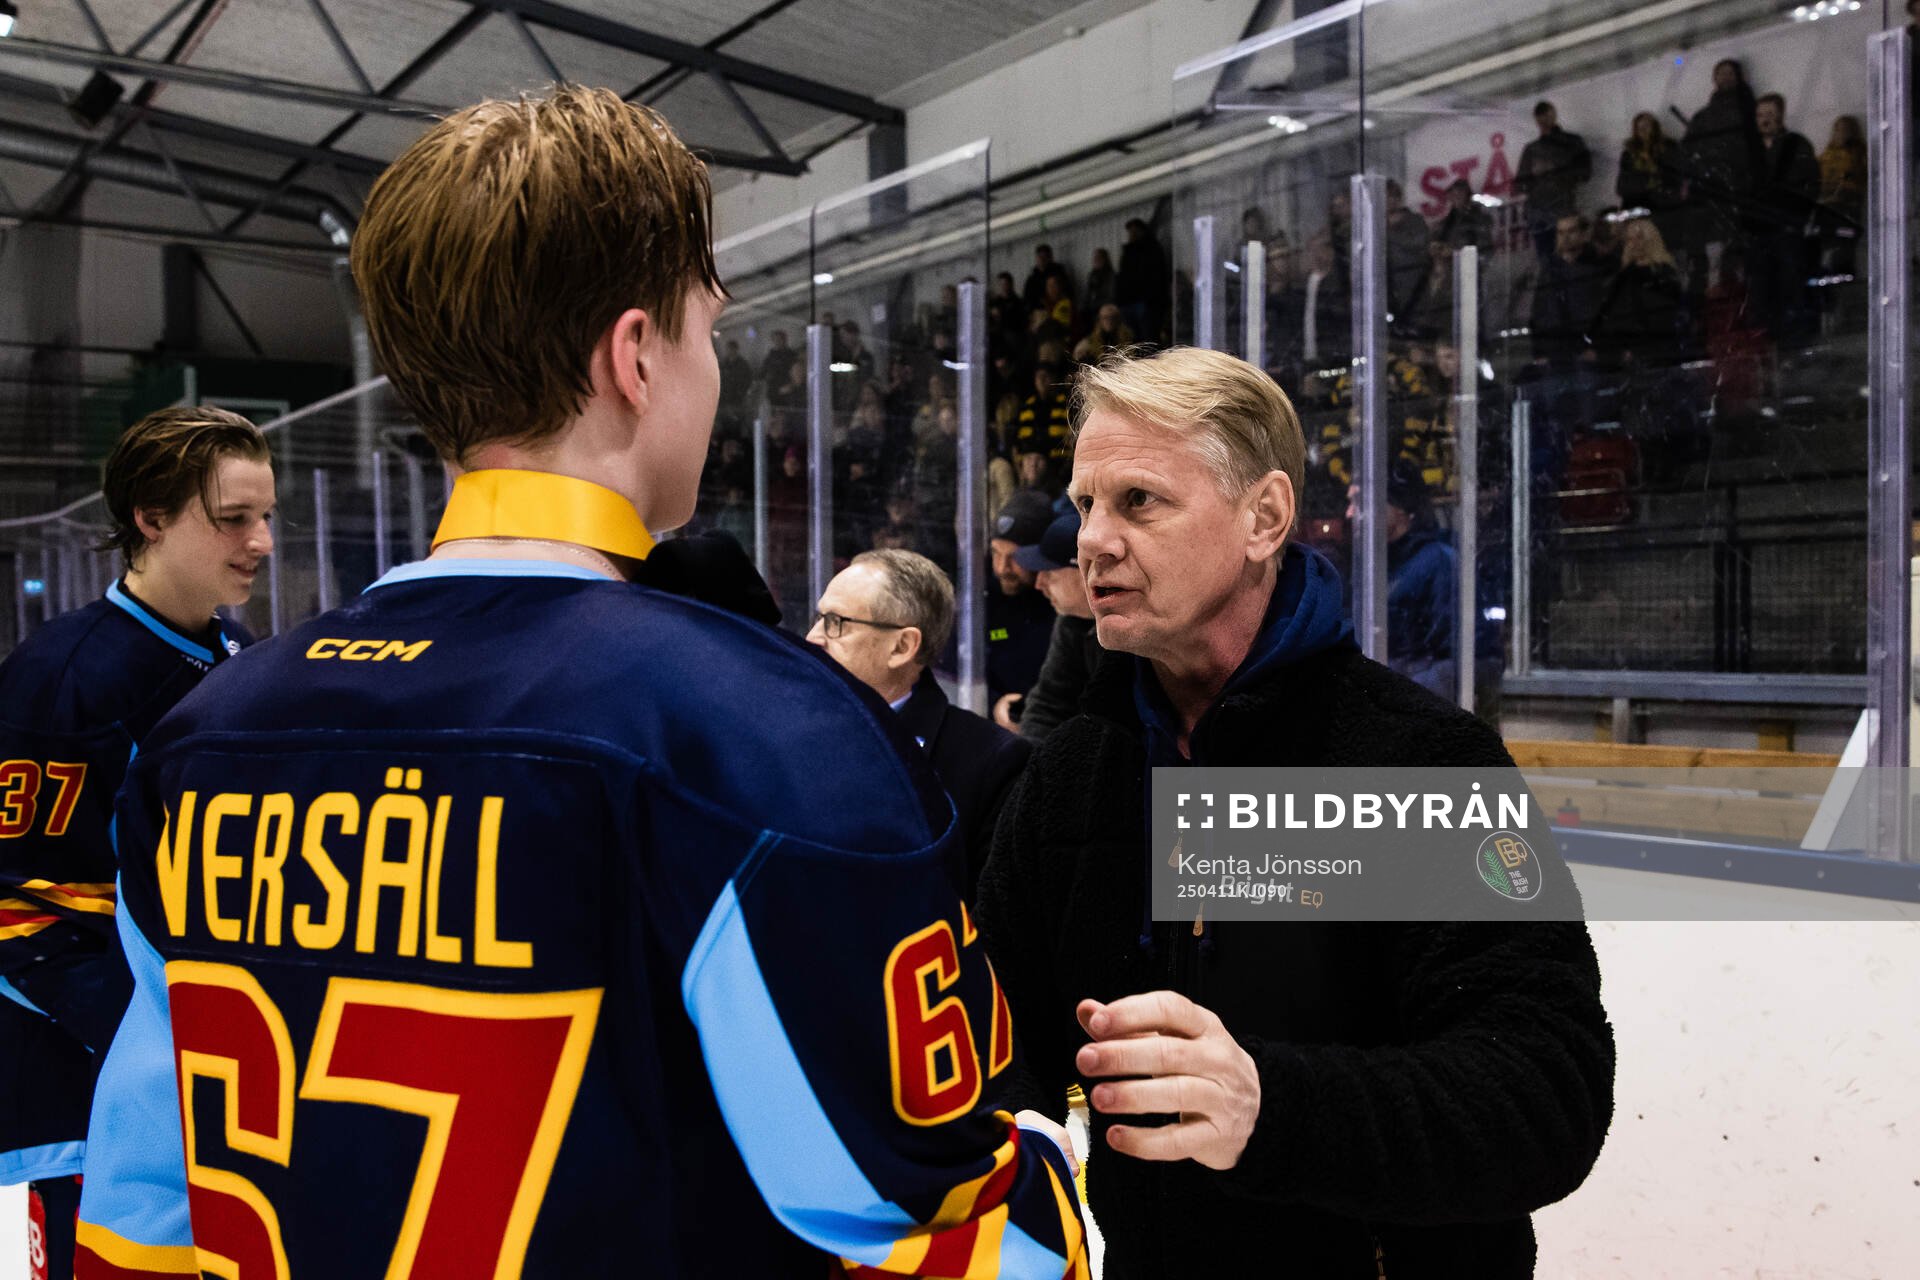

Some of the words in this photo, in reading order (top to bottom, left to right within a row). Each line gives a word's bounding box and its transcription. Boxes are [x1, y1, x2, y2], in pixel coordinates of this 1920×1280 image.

[305, 637, 434, 662] CCM
[0, 759, 88, 838] 37
[156, 766, 533, 969] VERSÄLL
[1219, 875, 1294, 905] Bright
[1301, 889, 1323, 908] EQ
[165, 958, 605, 1280] 67
